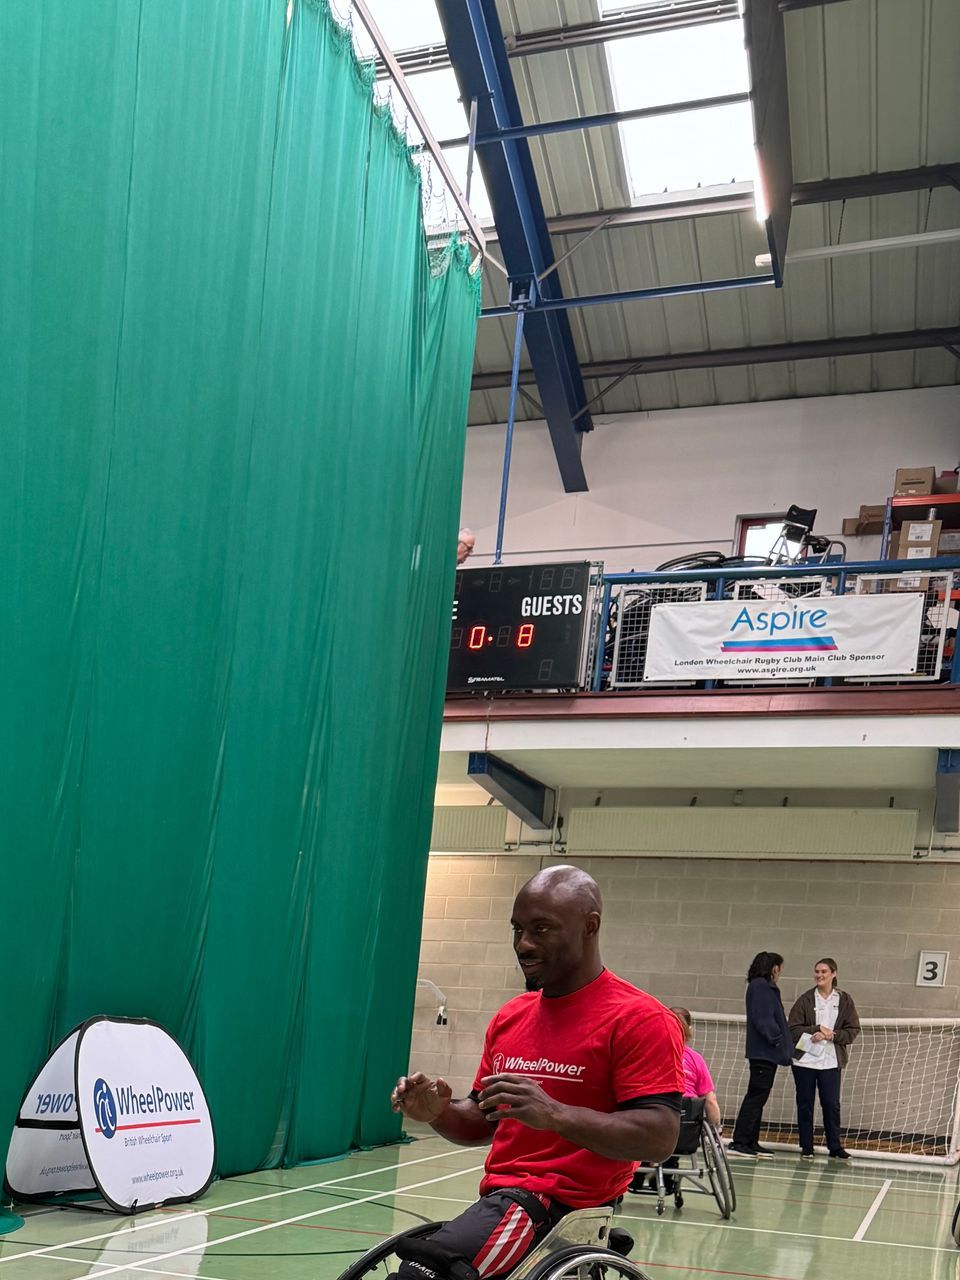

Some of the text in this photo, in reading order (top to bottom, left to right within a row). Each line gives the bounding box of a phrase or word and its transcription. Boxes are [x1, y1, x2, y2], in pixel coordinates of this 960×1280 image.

[521, 595, 583, 617] GUESTS
[730, 605, 828, 635] Aspire
[517, 623, 534, 647] 8
[706, 657, 753, 665] Wheelchair
[754, 657, 782, 666] Rugby
[849, 653, 885, 661] Sponsor
[737, 665, 817, 674] www.aspire.org.uk
[923, 961, 939, 981] 3
[504, 1056, 586, 1076] WheelPower
[116, 1085, 194, 1115] WheelPower
[161, 1132, 172, 1144] Sport
